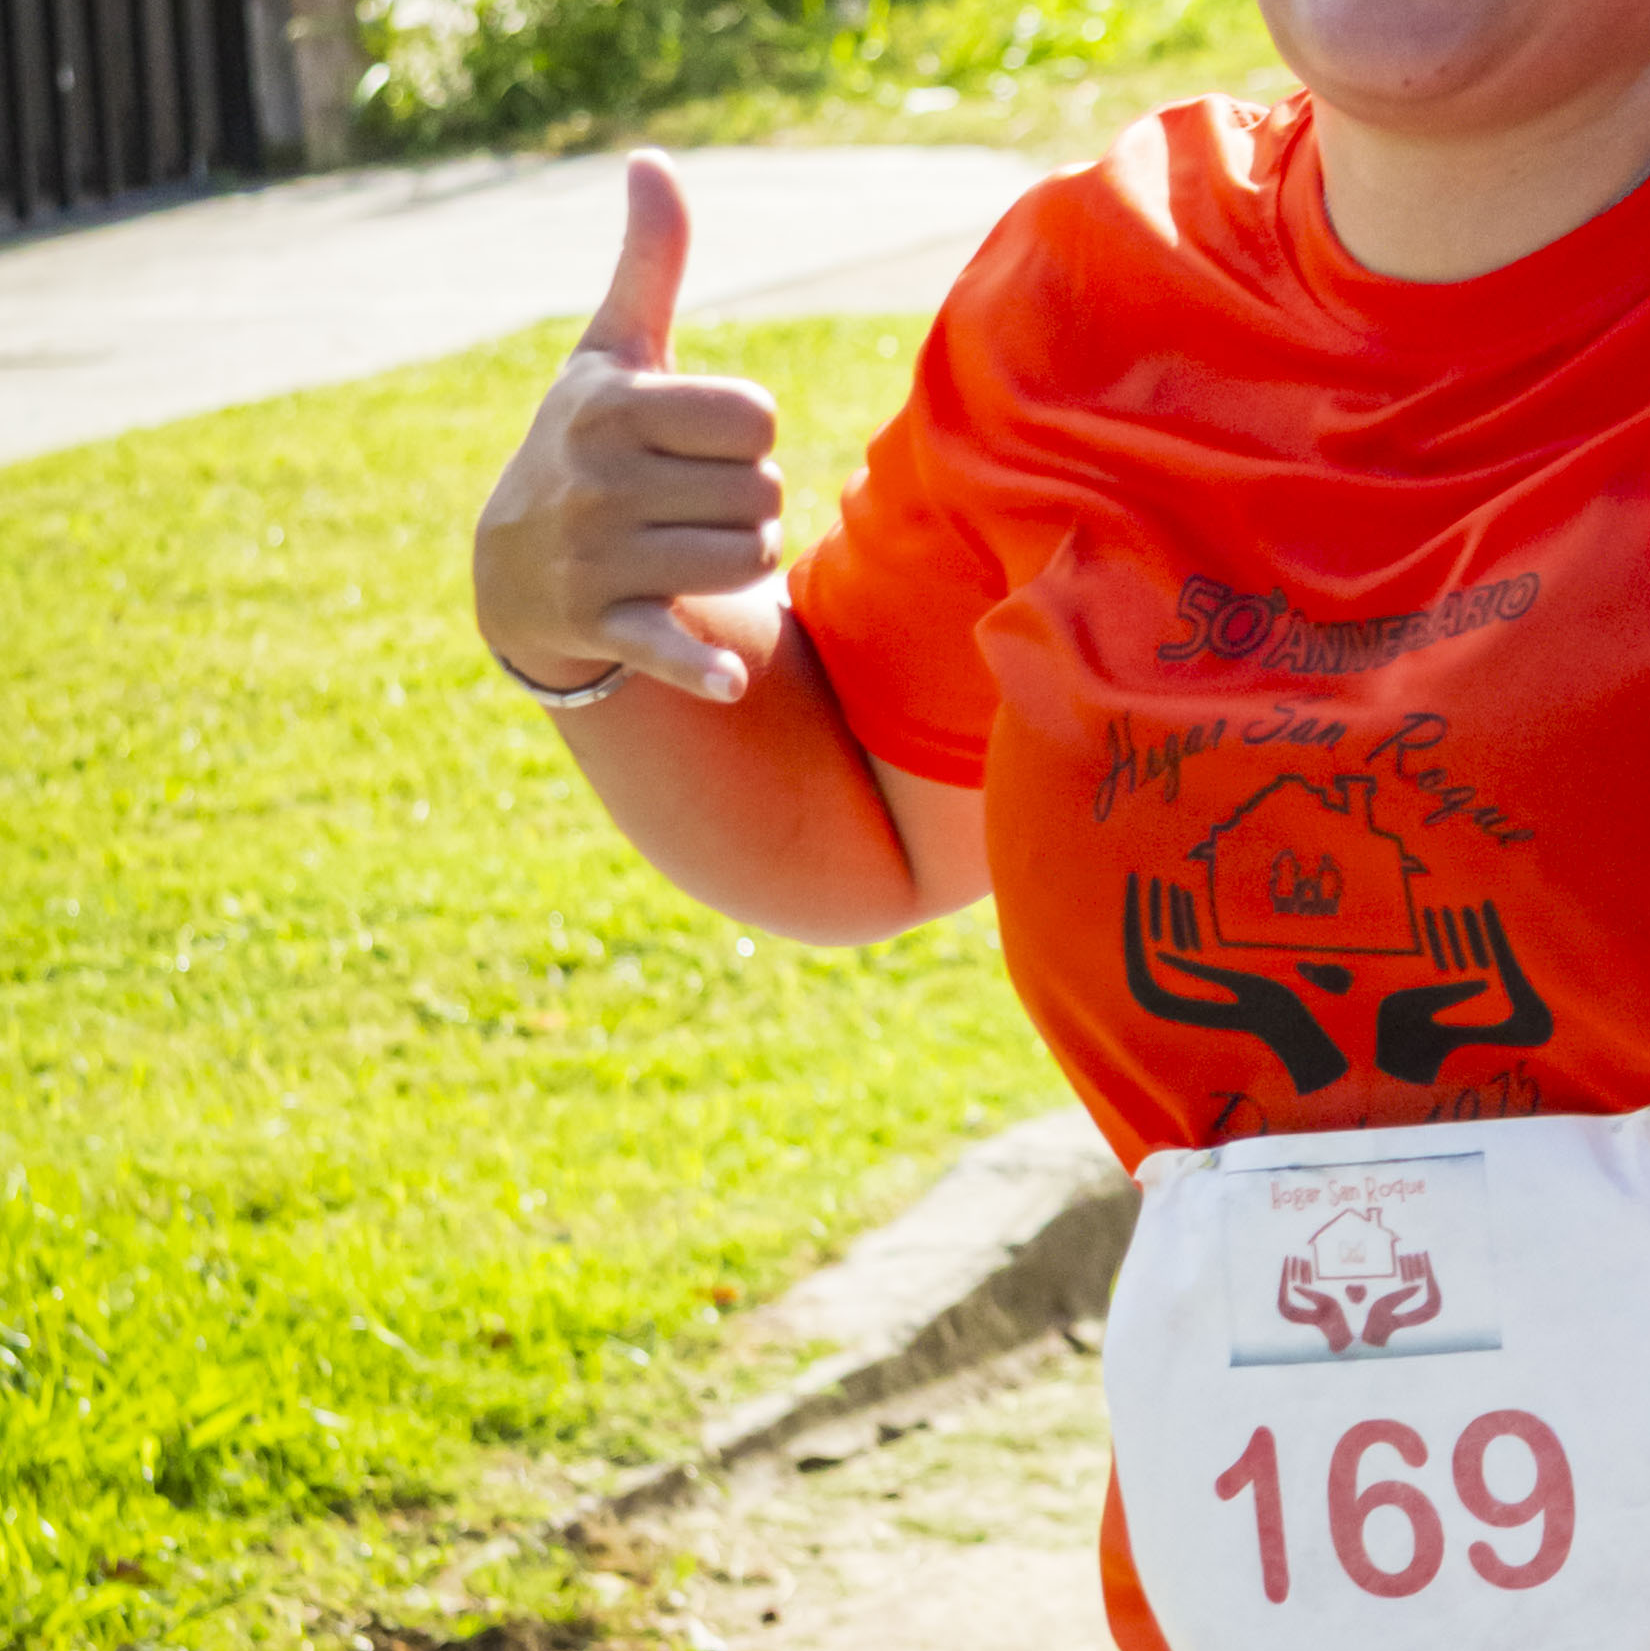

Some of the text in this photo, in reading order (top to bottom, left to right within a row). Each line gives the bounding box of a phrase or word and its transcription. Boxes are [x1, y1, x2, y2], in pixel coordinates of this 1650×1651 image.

[1242, 703, 1348, 751] San
[1270, 1176, 1425, 1212] Hogar San Roque
[1214, 1409, 1576, 1605] 169
